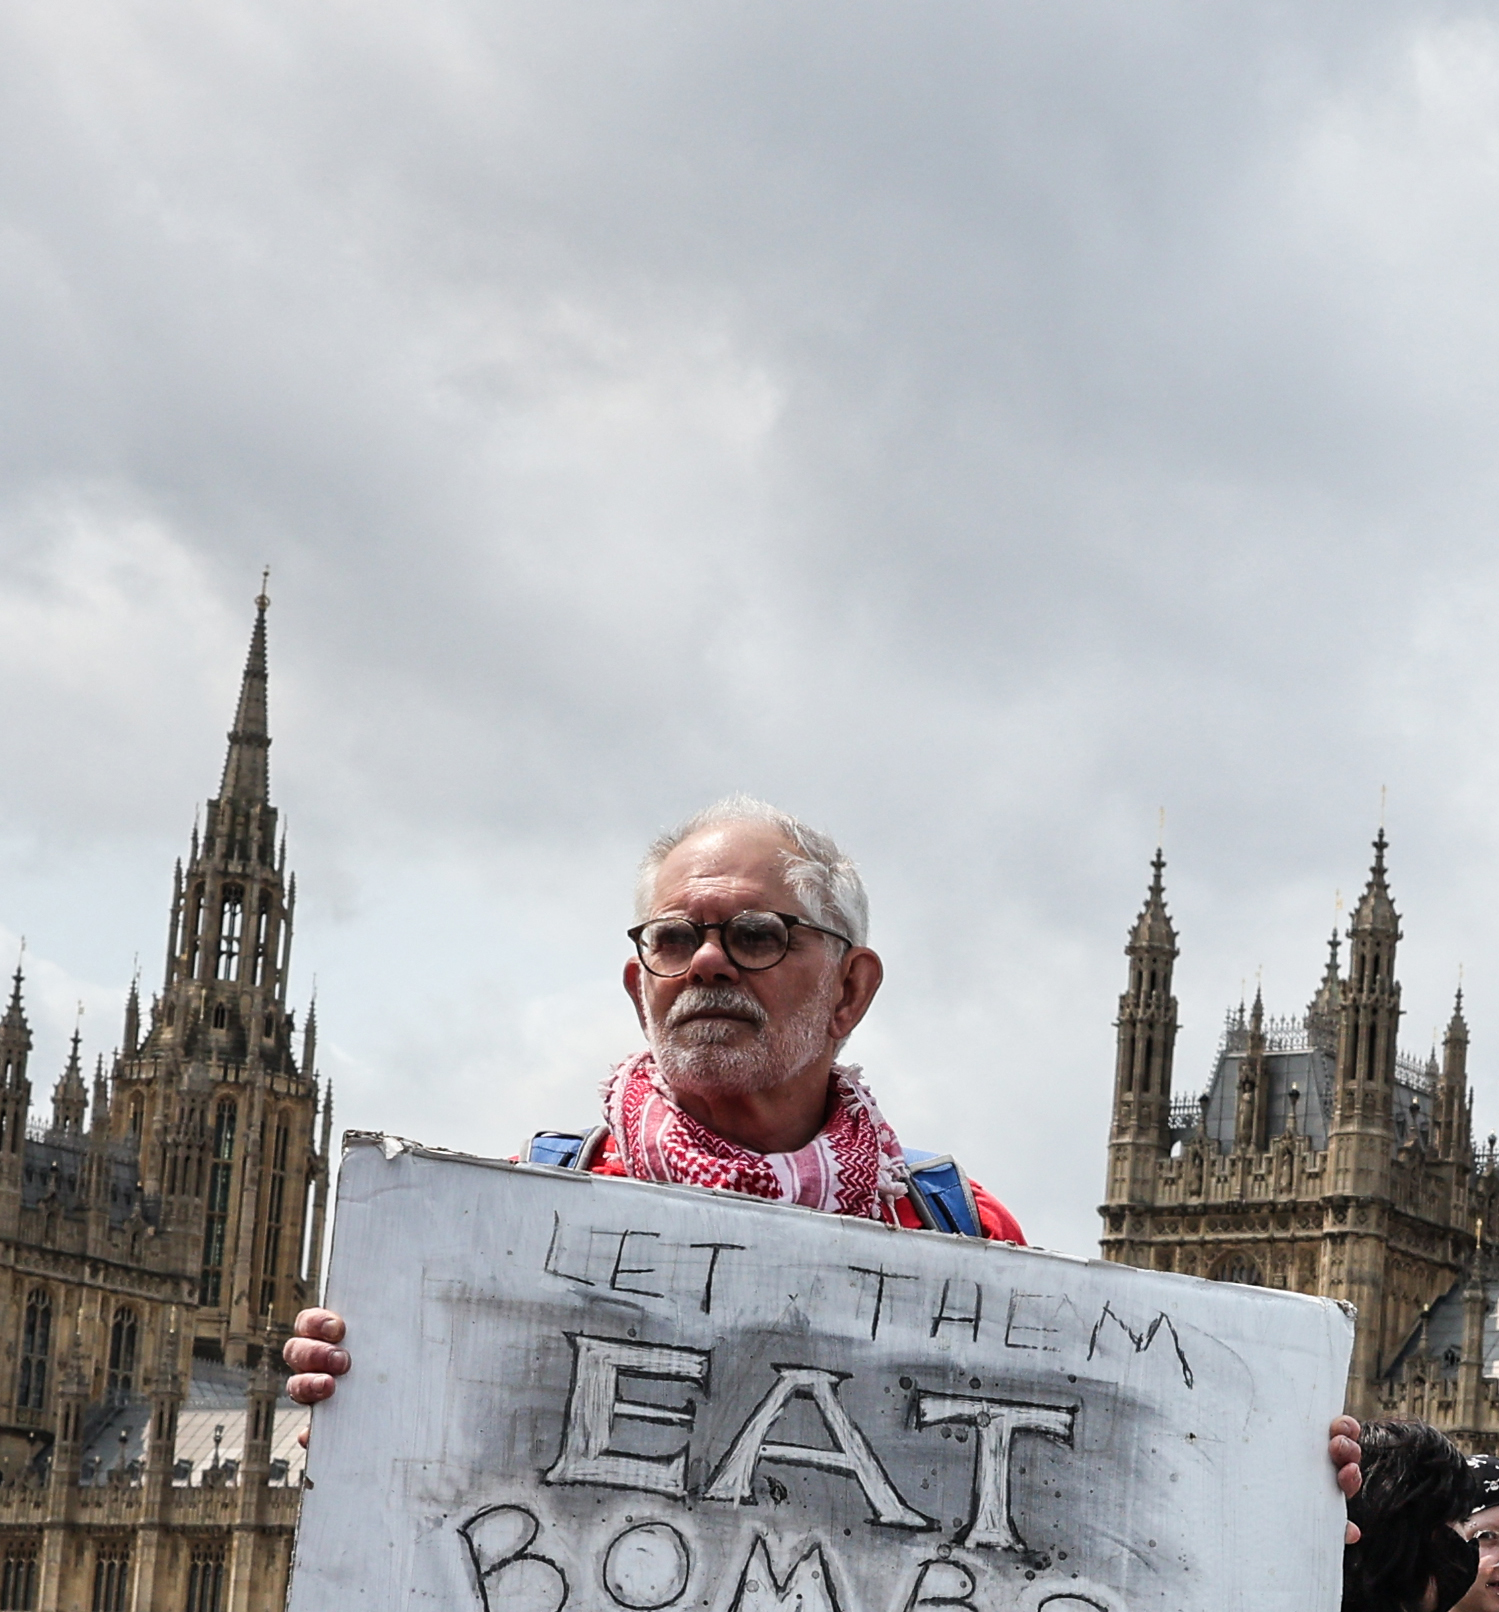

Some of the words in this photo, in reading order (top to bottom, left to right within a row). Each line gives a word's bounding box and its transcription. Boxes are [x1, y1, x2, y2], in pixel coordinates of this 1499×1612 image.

[543, 1210, 747, 1315] LET
[847, 1263, 1195, 1390] THEM
[543, 1330, 1081, 1552] EAT
